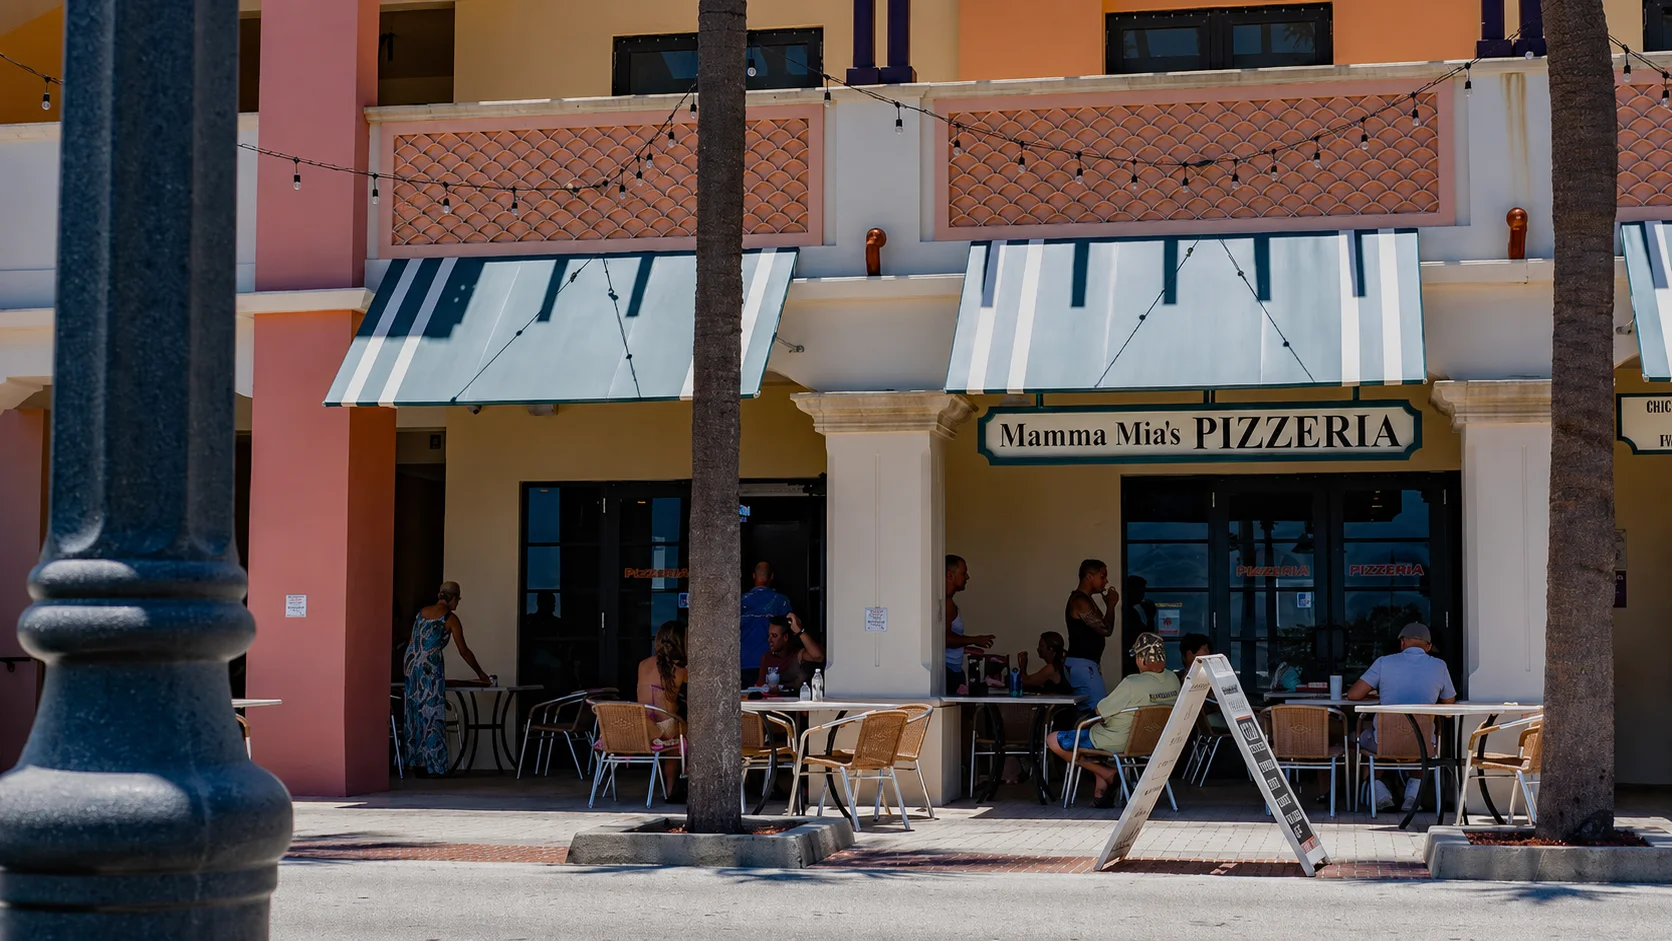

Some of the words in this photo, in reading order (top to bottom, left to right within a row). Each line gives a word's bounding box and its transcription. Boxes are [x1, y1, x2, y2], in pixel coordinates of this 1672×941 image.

[999, 421, 1107, 448] Mamma
[1115, 419, 1181, 447] Mia's
[1193, 413, 1402, 450] PIZZERIA
[1236, 565, 1309, 577] PIZZERIA
[1350, 564, 1424, 576] PIZZERIA
